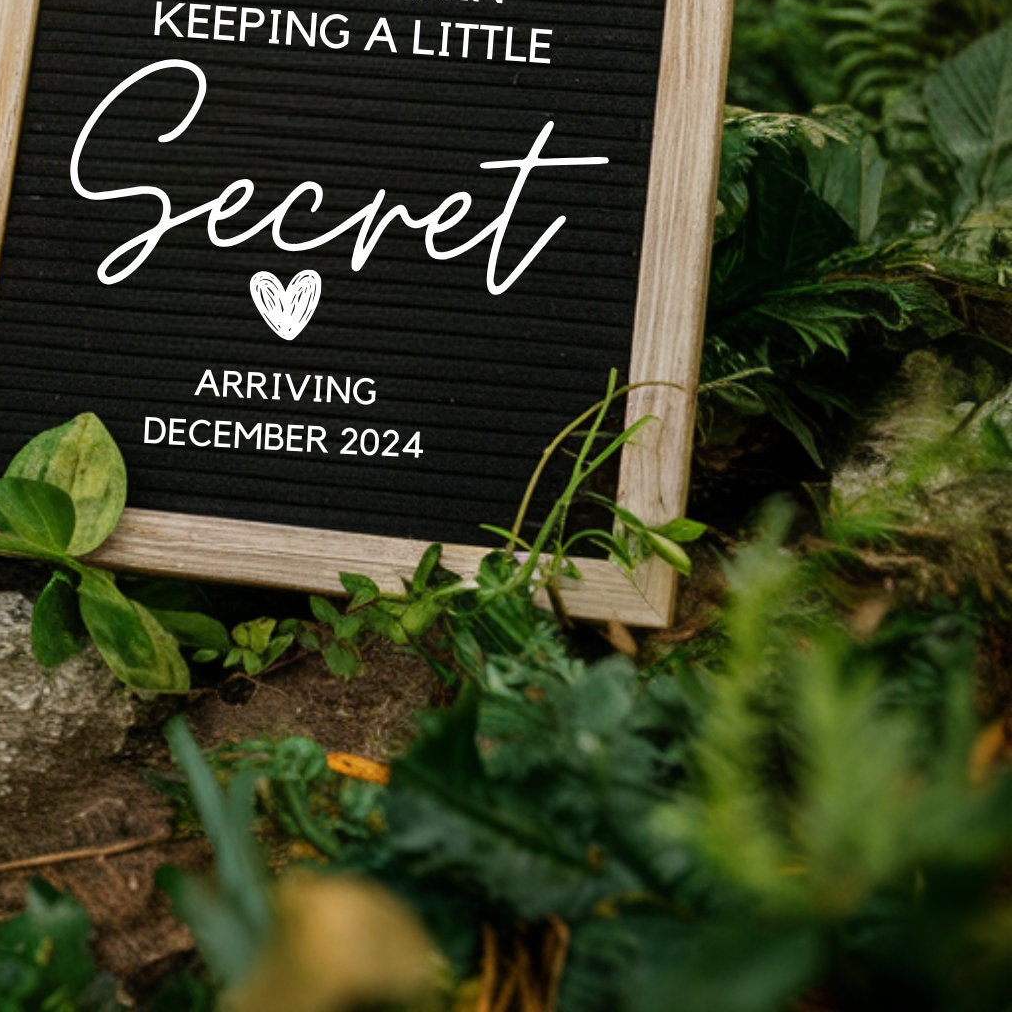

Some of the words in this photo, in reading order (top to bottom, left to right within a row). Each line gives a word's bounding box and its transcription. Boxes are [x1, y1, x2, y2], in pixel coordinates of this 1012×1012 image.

[154, 1, 350, 50] KEEPING
[363, 17, 398, 53] A
[412, 19, 553, 64] LITTLE
[69, 58, 610, 296] Secret
[193, 369, 377, 406] ARRIVING
[143, 416, 329, 454] DECEMBER
[339, 427, 424, 459] 2024
